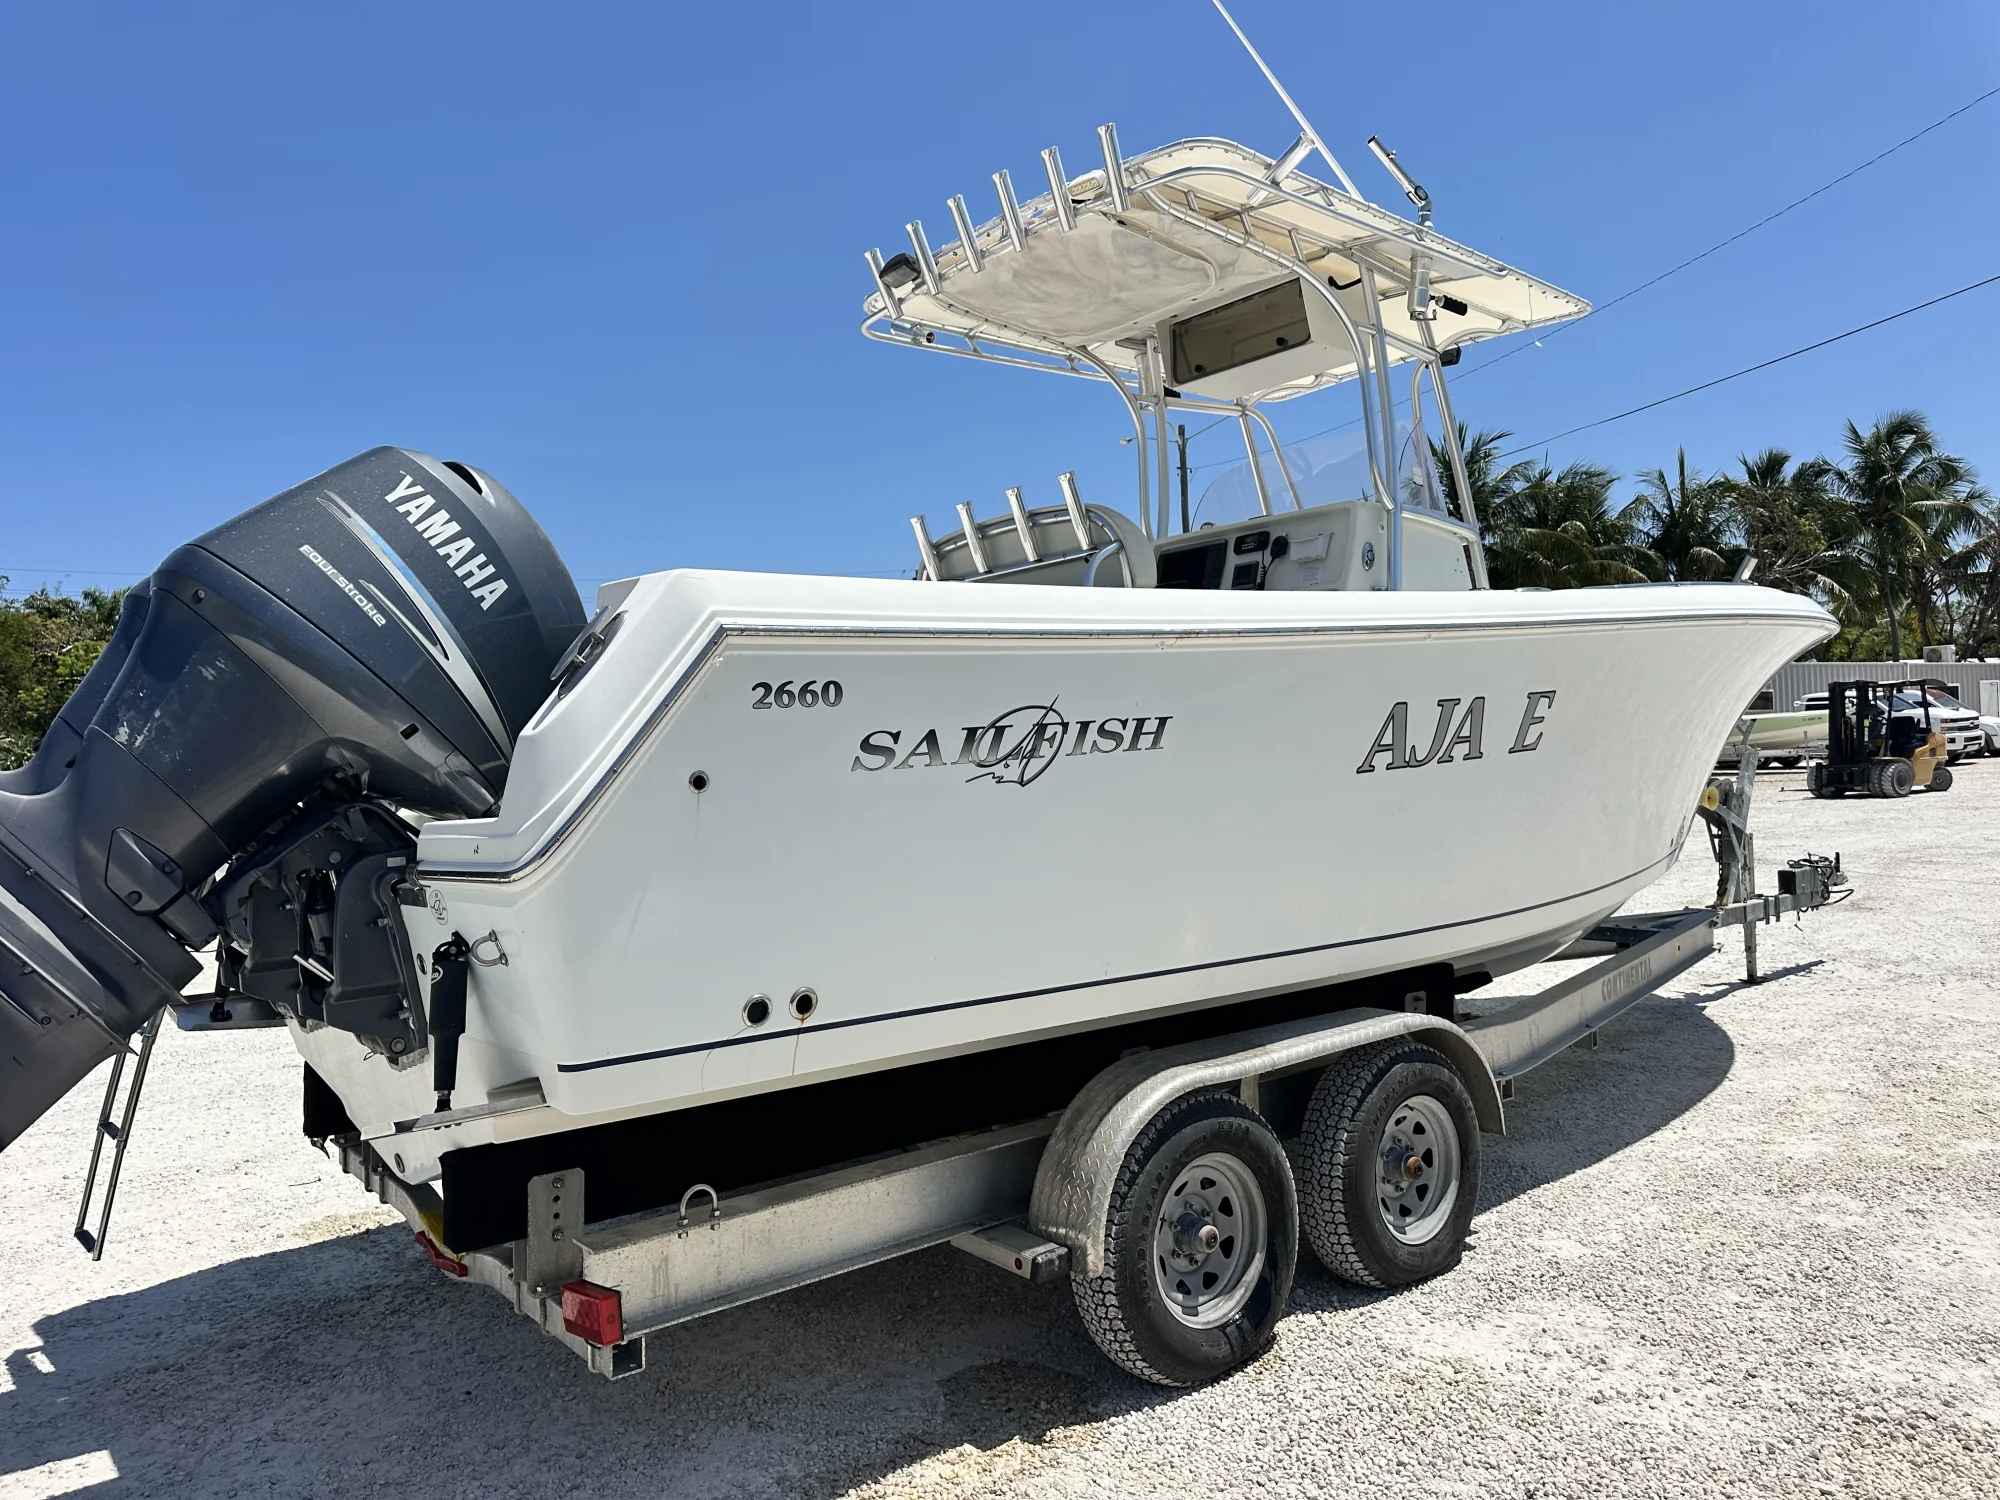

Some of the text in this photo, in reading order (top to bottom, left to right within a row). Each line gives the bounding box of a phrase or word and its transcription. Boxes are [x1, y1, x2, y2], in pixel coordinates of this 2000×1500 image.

[384, 472, 508, 611] YAMAHA
[751, 680, 843, 710] 2660
[851, 716, 1173, 773] SAILFISH
[1356, 690, 1556, 774] AJA E
[1602, 957, 1652, 1001] CONTINENTAL
